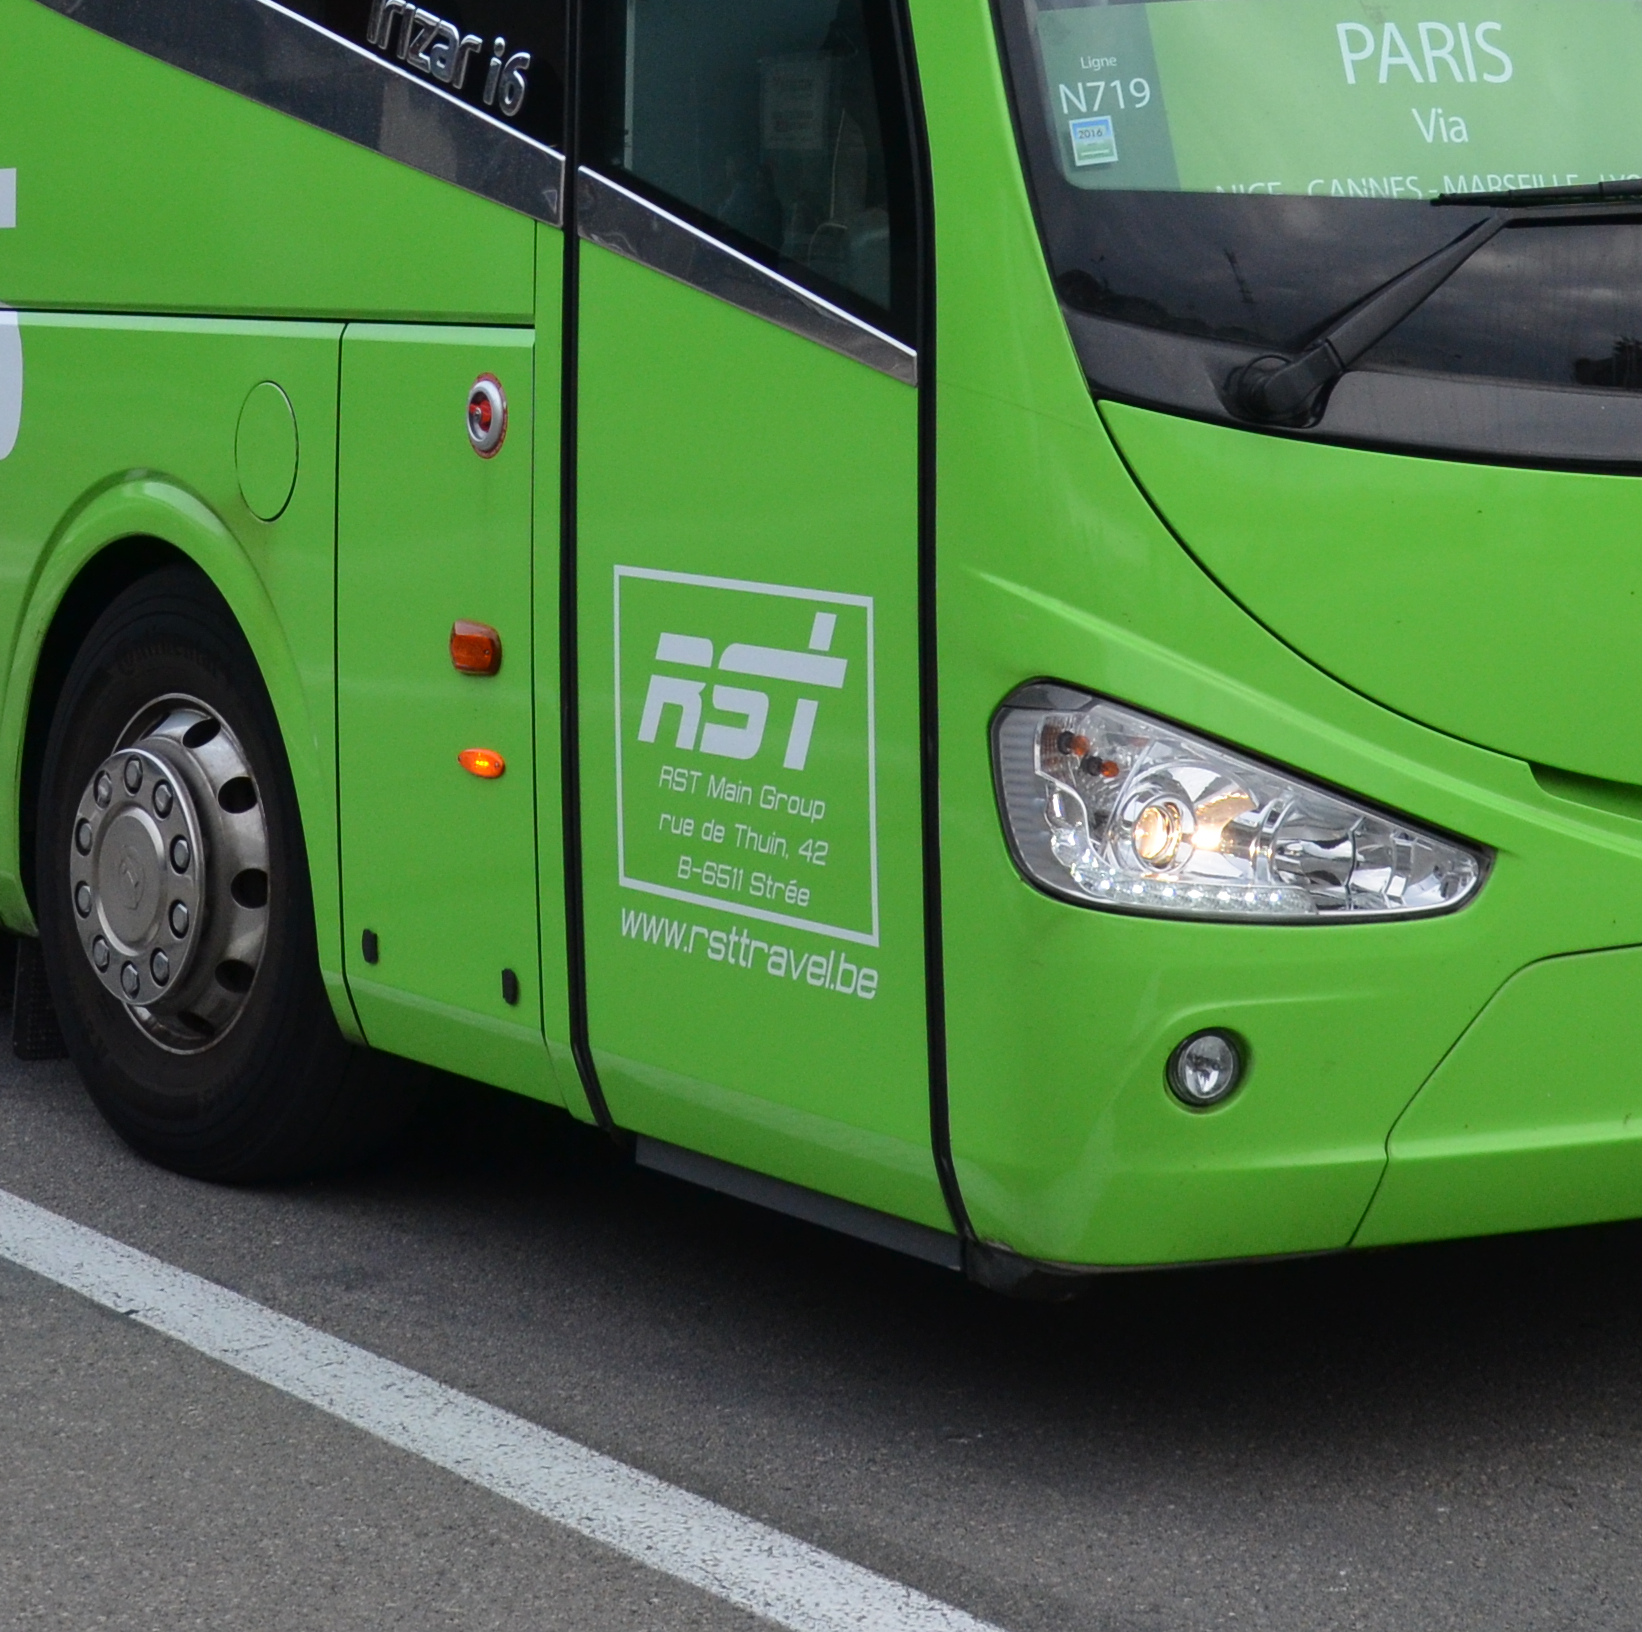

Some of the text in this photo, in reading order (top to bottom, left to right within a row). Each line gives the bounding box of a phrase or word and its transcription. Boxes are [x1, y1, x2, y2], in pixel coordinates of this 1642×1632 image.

[483, 36, 531, 117] i6
[1080, 55, 1118, 72] Ligne
[1335, 20, 1514, 85] PARIS
[1058, 77, 1151, 115] N719
[1078, 127, 1104, 140] 2016
[1411, 107, 1469, 144] Via
[1215, 181, 1284, 196] CE
[637, 611, 849, 771] RST
[658, 764, 827, 823] RST Main Group
[658, 810, 830, 867] rue de Thuin, 42
[677, 855, 811, 908] B-6511 Strée
[620, 906, 880, 1001] www.rsttravel.be
